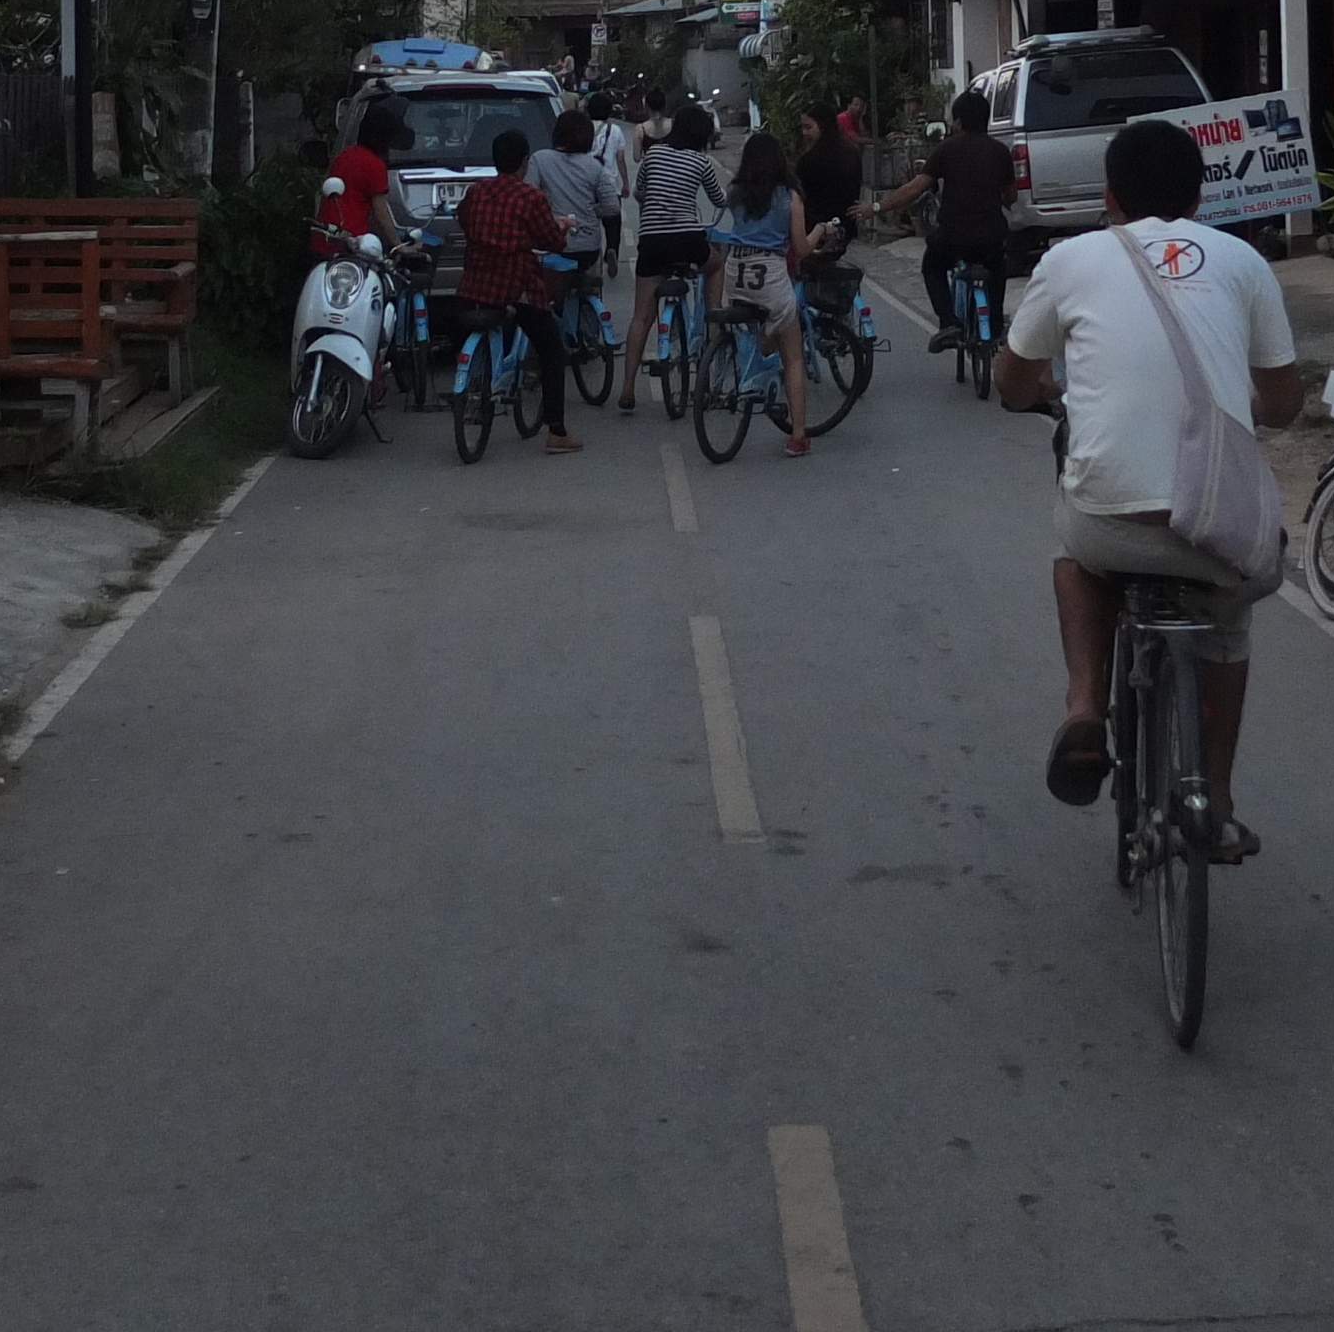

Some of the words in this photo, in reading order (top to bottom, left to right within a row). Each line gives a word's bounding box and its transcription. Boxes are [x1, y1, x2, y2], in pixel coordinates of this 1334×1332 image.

[1181, 112, 1243, 148] ำหน่าย
[735, 262, 767, 290] 13
